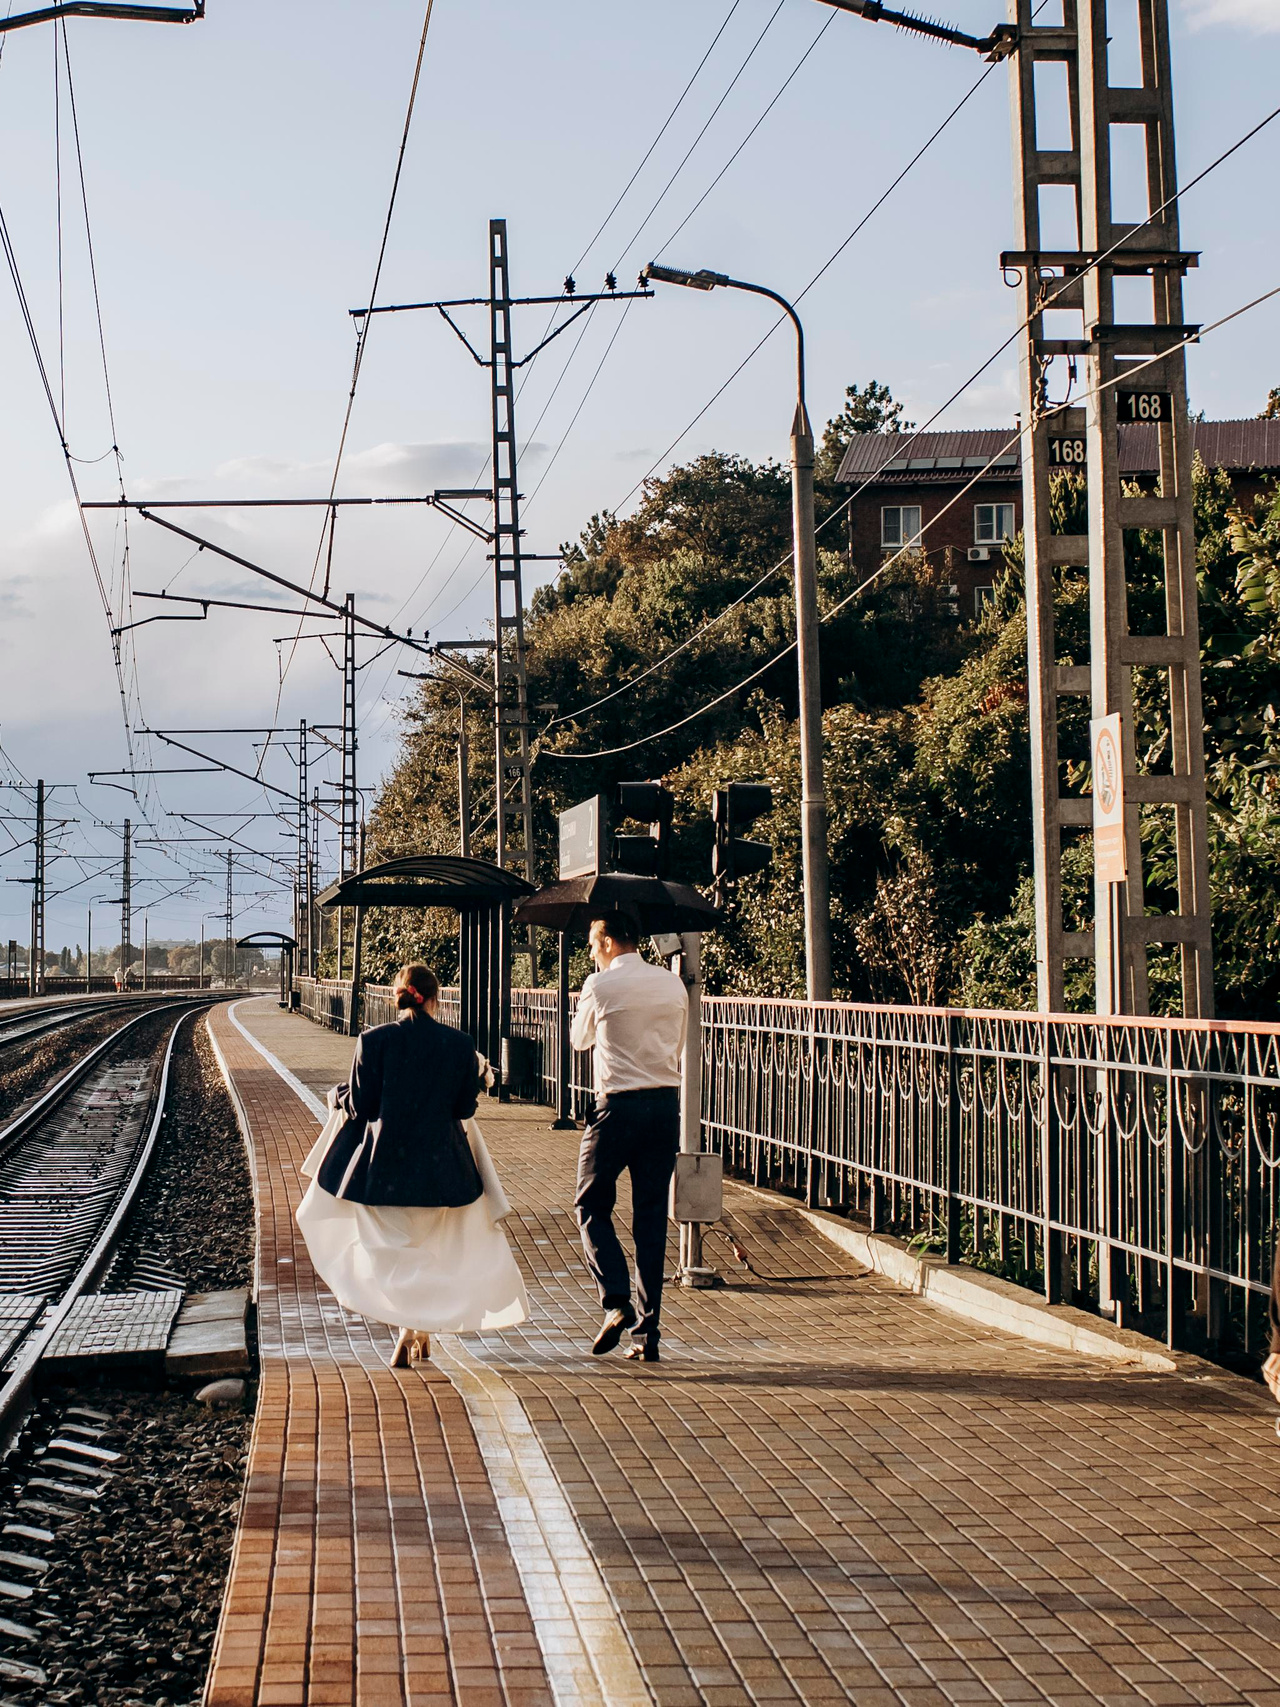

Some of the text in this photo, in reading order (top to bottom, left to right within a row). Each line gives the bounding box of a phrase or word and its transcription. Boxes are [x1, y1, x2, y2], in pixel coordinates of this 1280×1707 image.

[1128, 394, 1162, 418] 168
[1052, 440, 1087, 462] 168
[508, 768, 521, 777] 166
